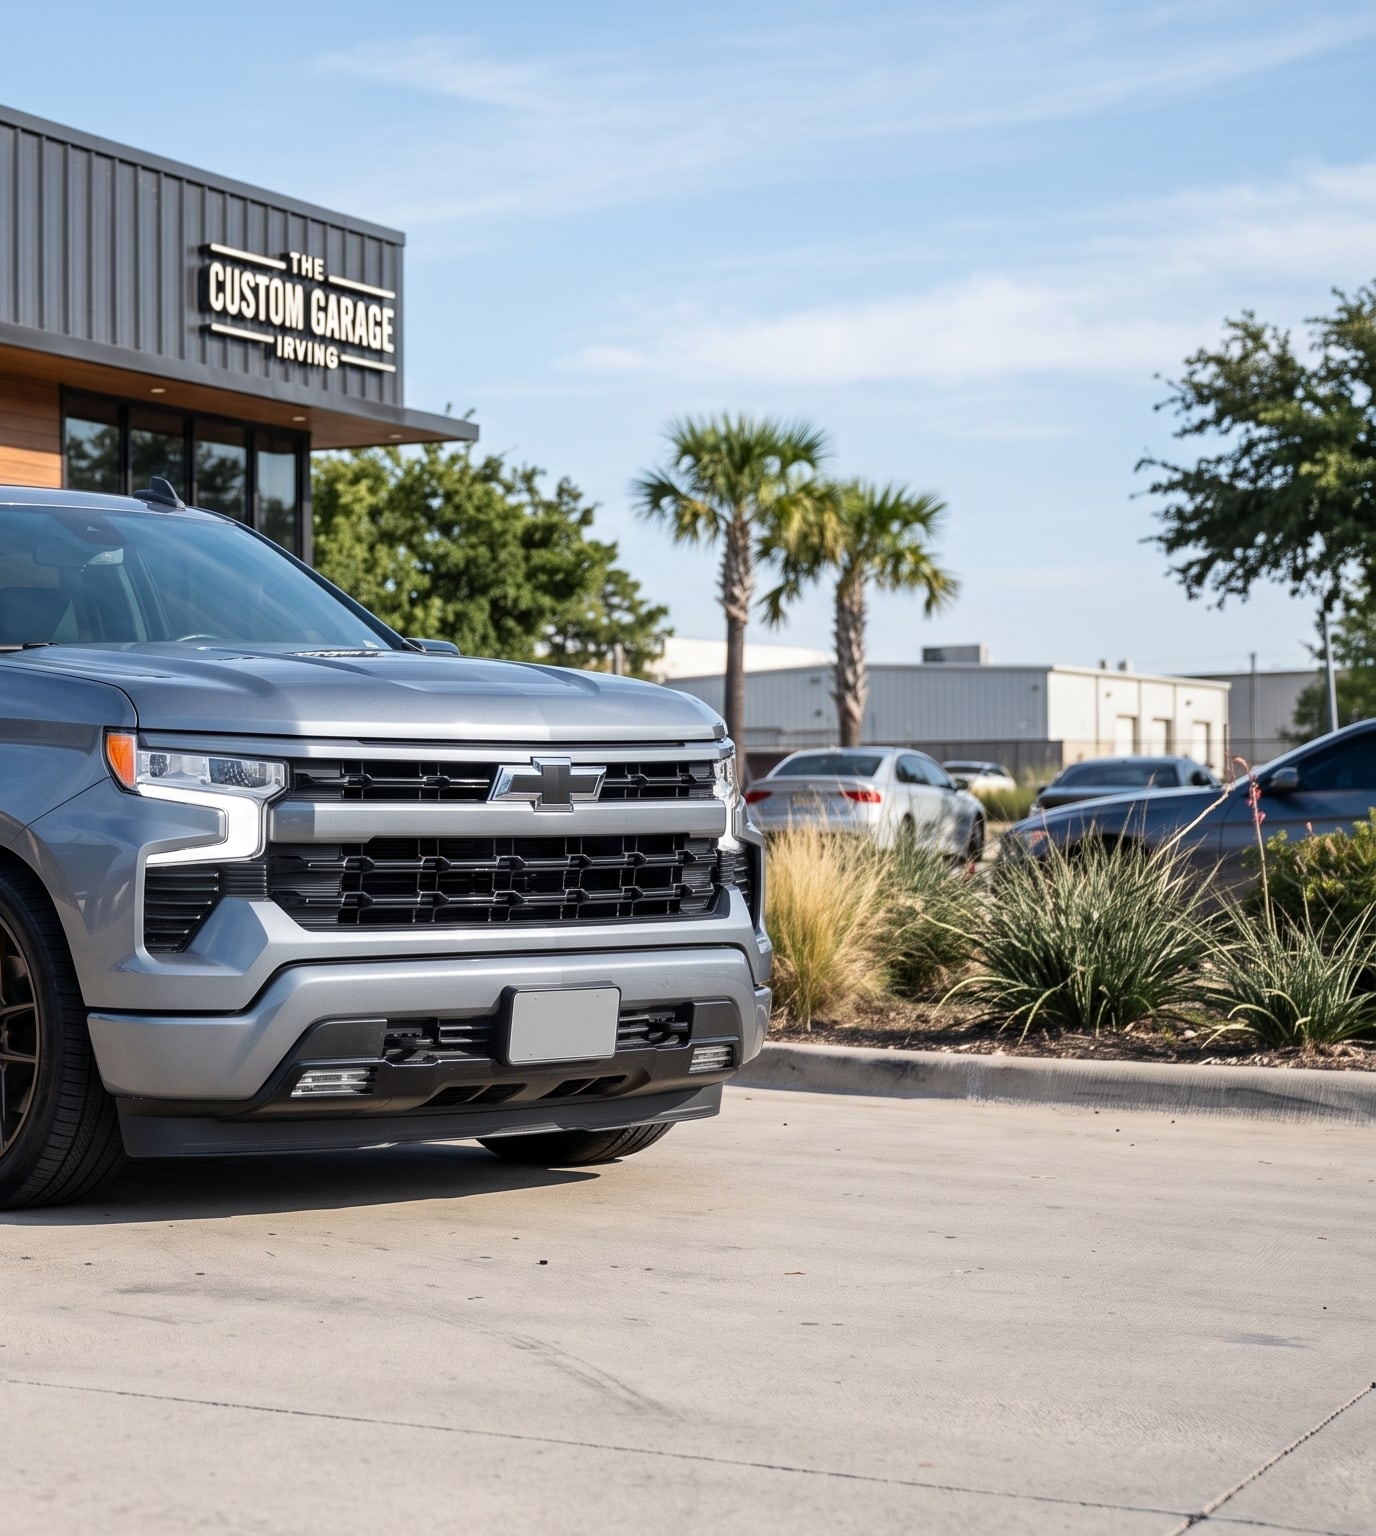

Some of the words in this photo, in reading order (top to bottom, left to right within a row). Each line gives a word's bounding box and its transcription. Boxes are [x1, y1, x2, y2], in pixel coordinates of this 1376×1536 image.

[289, 251, 325, 281] THE
[209, 262, 304, 330] CUSTOM
[310, 288, 395, 354] GARAGE
[276, 335, 339, 369] IRVING
